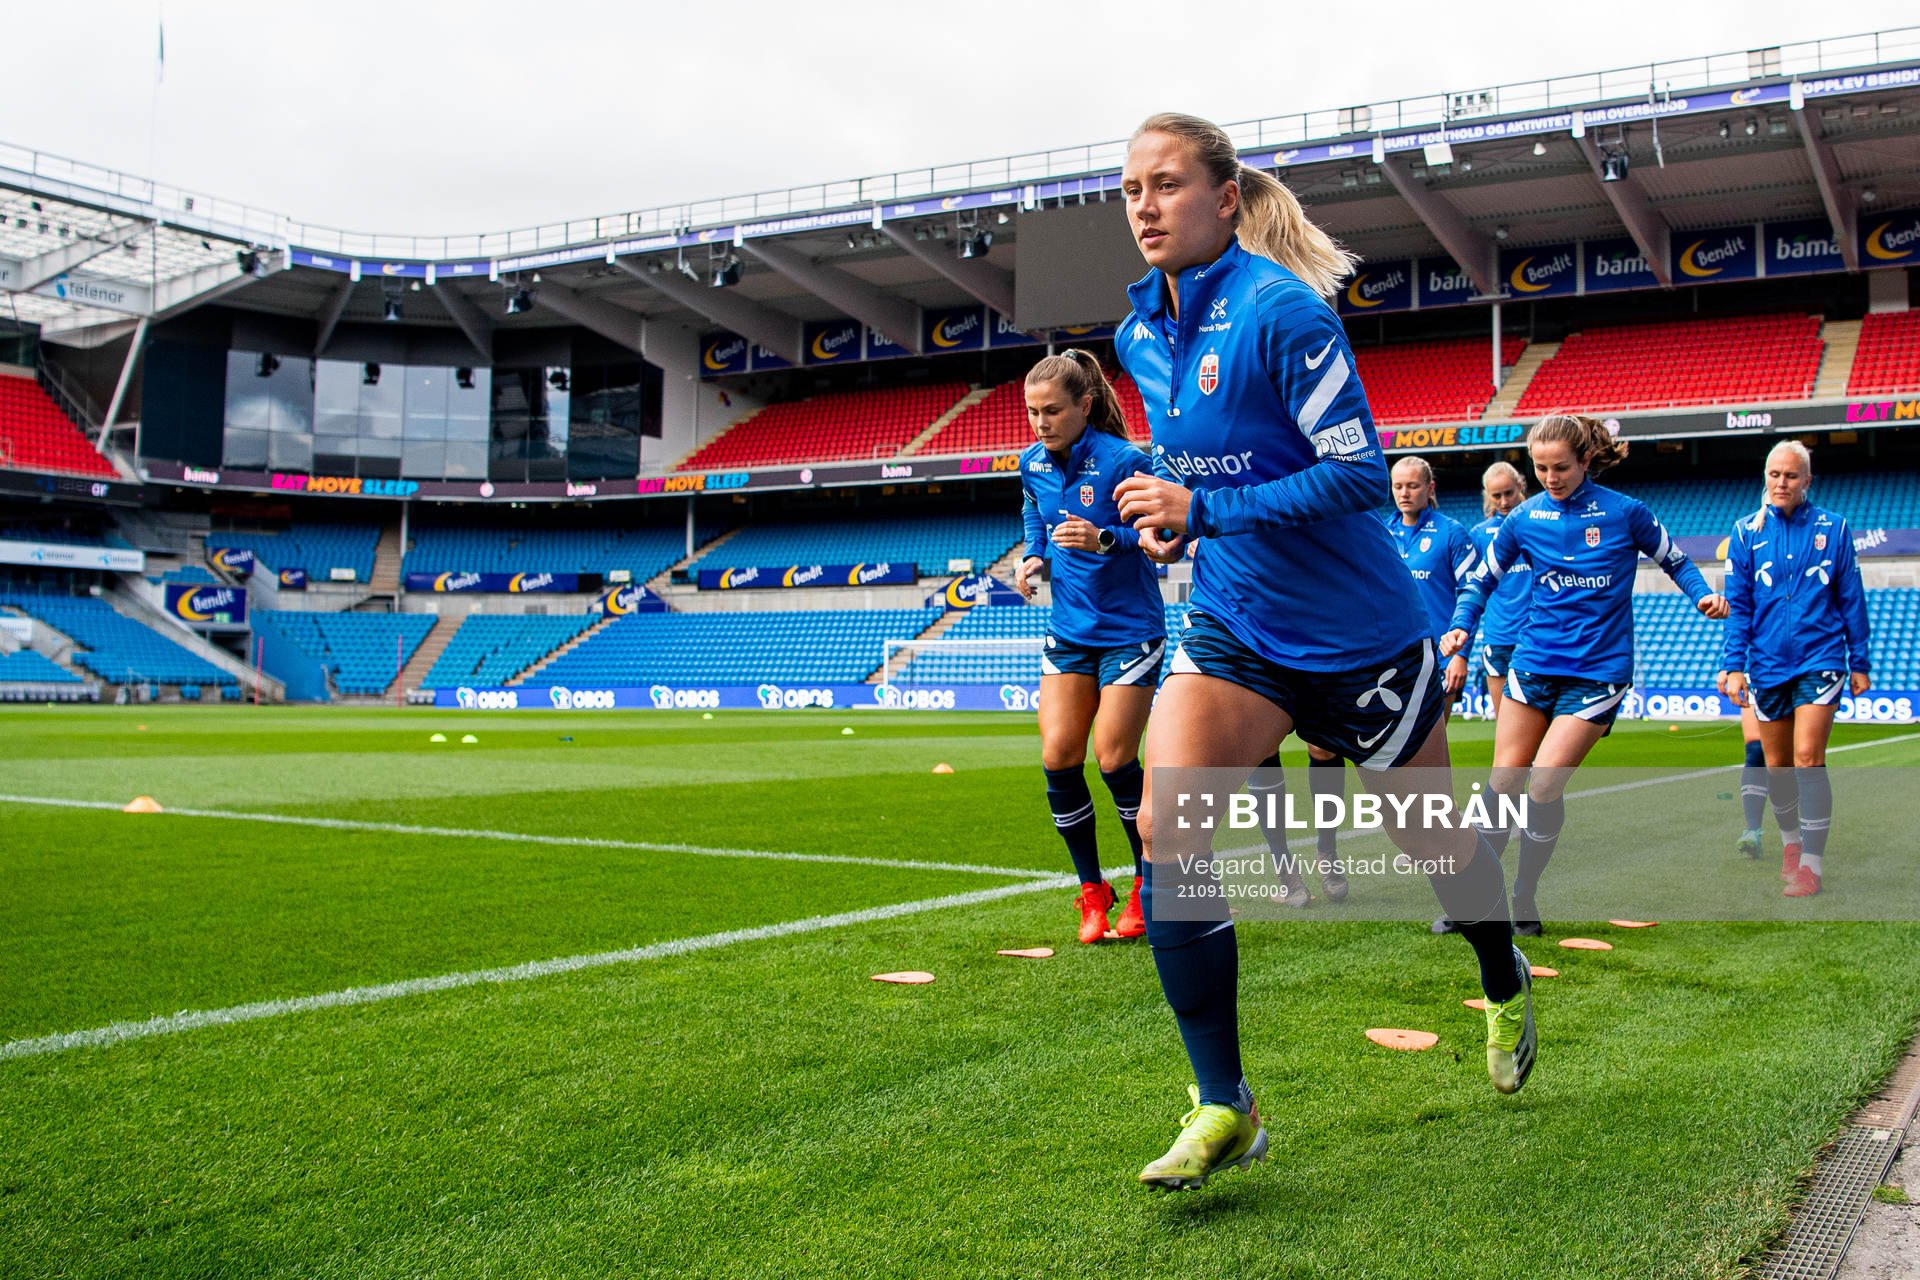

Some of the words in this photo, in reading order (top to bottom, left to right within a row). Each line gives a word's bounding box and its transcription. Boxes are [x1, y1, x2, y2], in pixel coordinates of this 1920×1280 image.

[1697, 236, 1746, 268] Bendit
[1527, 253, 1573, 283] Bendit
[1362, 270, 1405, 298] Bendit
[944, 314, 979, 339] Bendit
[823, 327, 855, 351] Bendit
[1726, 412, 1772, 429] bama
[1846, 400, 1894, 423] EAT
[1318, 424, 1361, 456] DNB
[1395, 428, 1456, 448] MOVE
[1458, 424, 1524, 445] SLEEP
[881, 464, 913, 479] bama
[959, 457, 992, 474] EAT
[992, 454, 1020, 472] MO
[1167, 450, 1252, 476] telenor
[271, 474, 308, 491] EAT
[307, 476, 361, 495] MOVE
[363, 479, 419, 497] SLEEP
[638, 478, 664, 494] EAT
[664, 475, 705, 492] MOVE
[705, 473, 750, 490] SLEEP
[730, 566, 760, 588] Bendit
[793, 565, 824, 586] Bendit
[859, 563, 891, 585] Bendit
[1558, 574, 1613, 589] telenor
[958, 575, 994, 600] Bendit
[192, 587, 235, 612] Bendit
[477, 690, 518, 709] OBOS
[572, 690, 616, 709] OBOS
[674, 689, 720, 709] OBOS
[902, 689, 956, 709] OBOS
[1646, 694, 1722, 716] OBOS
